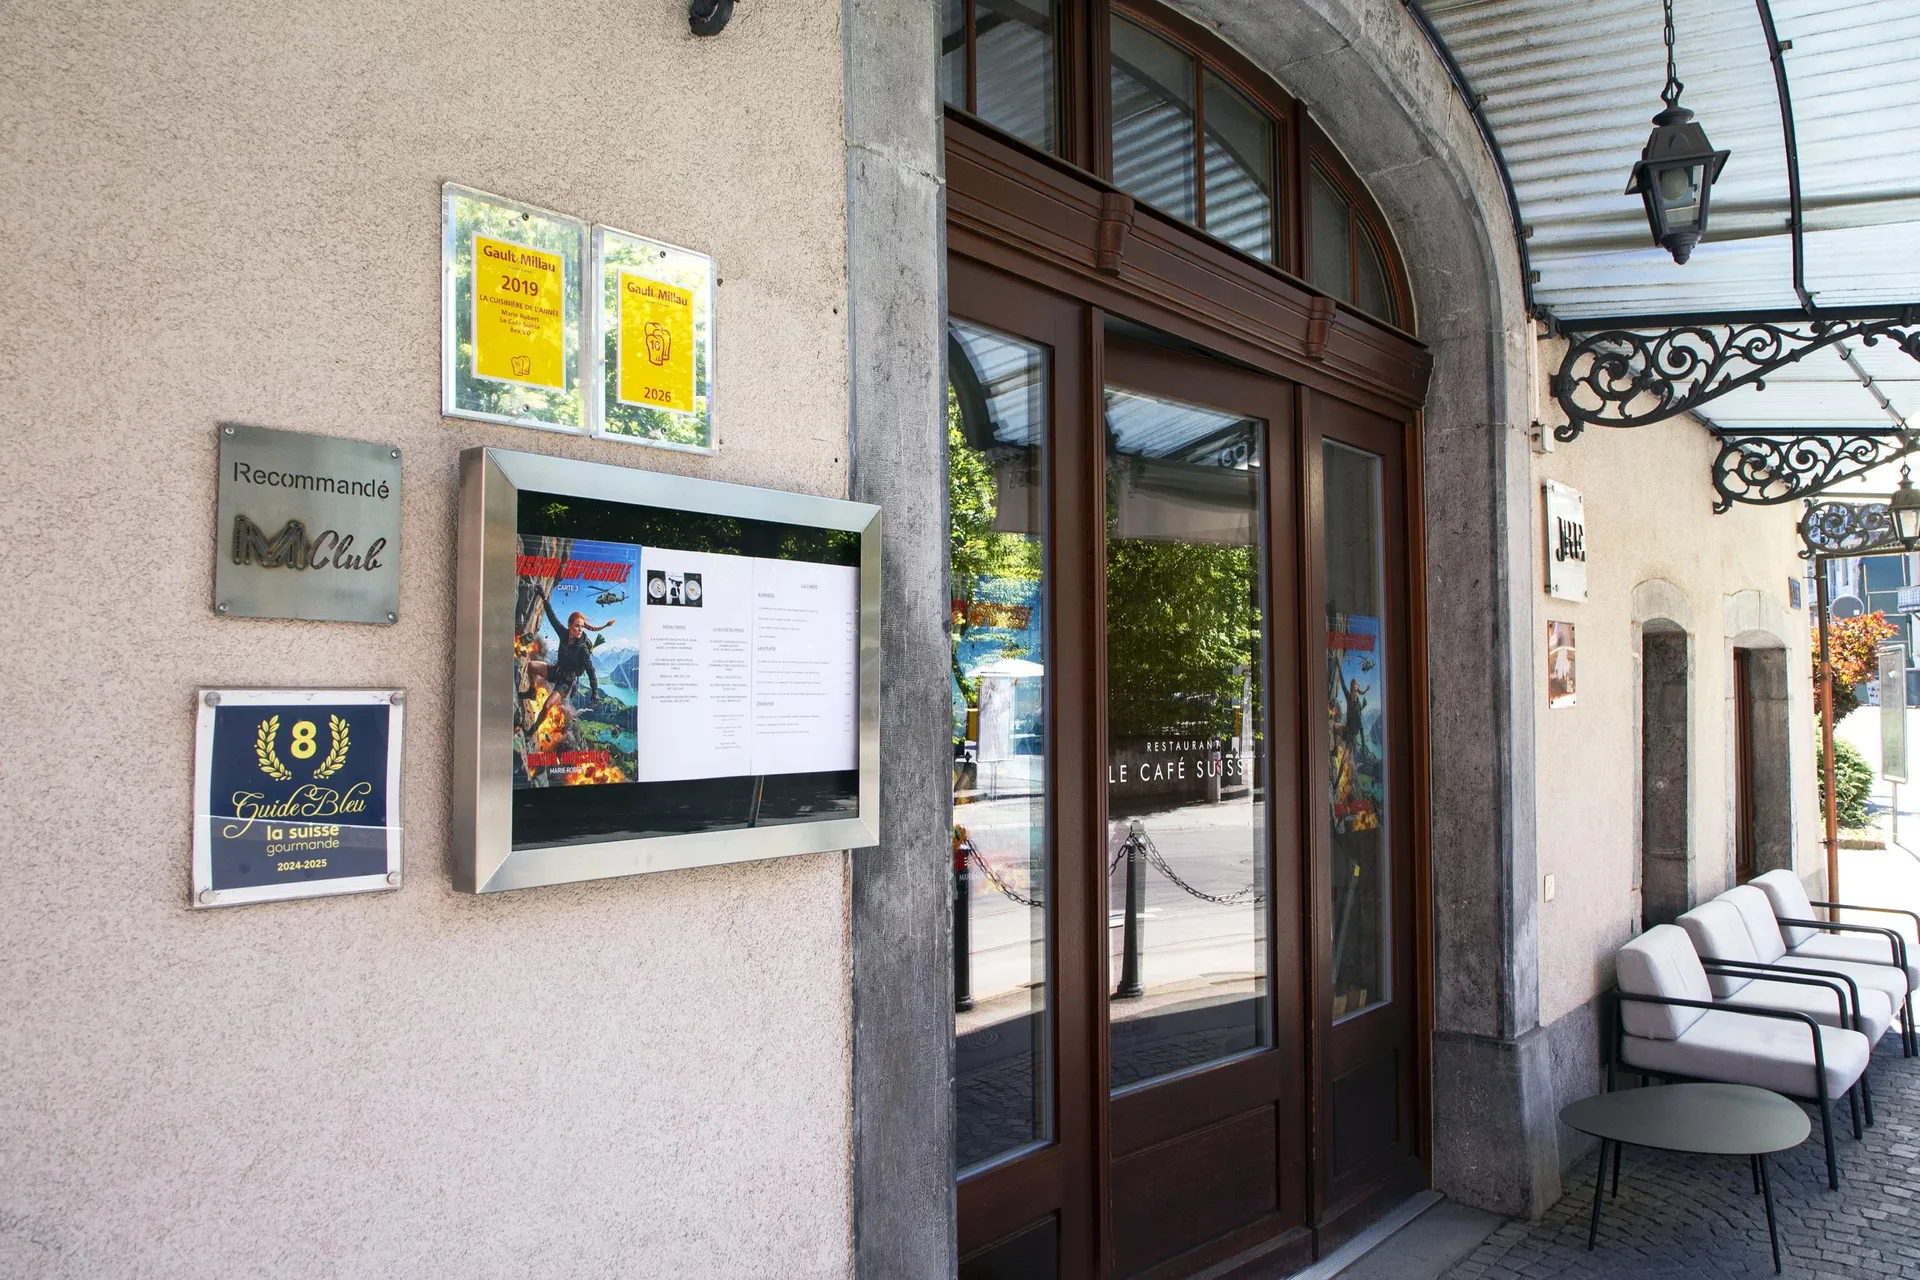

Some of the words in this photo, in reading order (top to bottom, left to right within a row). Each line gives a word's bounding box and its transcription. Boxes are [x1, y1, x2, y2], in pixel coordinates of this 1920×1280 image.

[483, 245, 516, 263] Gault
[520, 254, 555, 272] Millau
[501, 275, 538, 296] 2019
[627, 281, 654, 298] Gault
[658, 289, 688, 306] Millau
[479, 294, 488, 302] LA
[489, 297, 523, 309] CUISINIÈRE
[534, 306, 559, 317] L'ANNÉE
[501, 309, 518, 318] Marie
[519, 312, 539, 322] Robert
[508, 318, 522, 326] Café
[522, 322, 540, 330] Suisse
[650, 339, 661, 351] 16
[644, 387, 671, 403] 2026
[233, 461, 389, 499] Recommandé
[1556, 516, 1586, 562] JRE
[560, 559, 633, 583] IMPOSSIBLE
[290, 720, 317, 759] 8
[1147, 740, 1220, 752] RESTAURANT
[1108, 765, 1127, 784] LE
[1140, 757, 1185, 782] CAFÉ
[223, 783, 318, 839] Guide
[301, 781, 372, 817] Bleu
[266, 825, 283, 841] la
[289, 822, 340, 839] suisse
[266, 837, 340, 857] gourmande
[277, 858, 327, 872] 2024-2025
